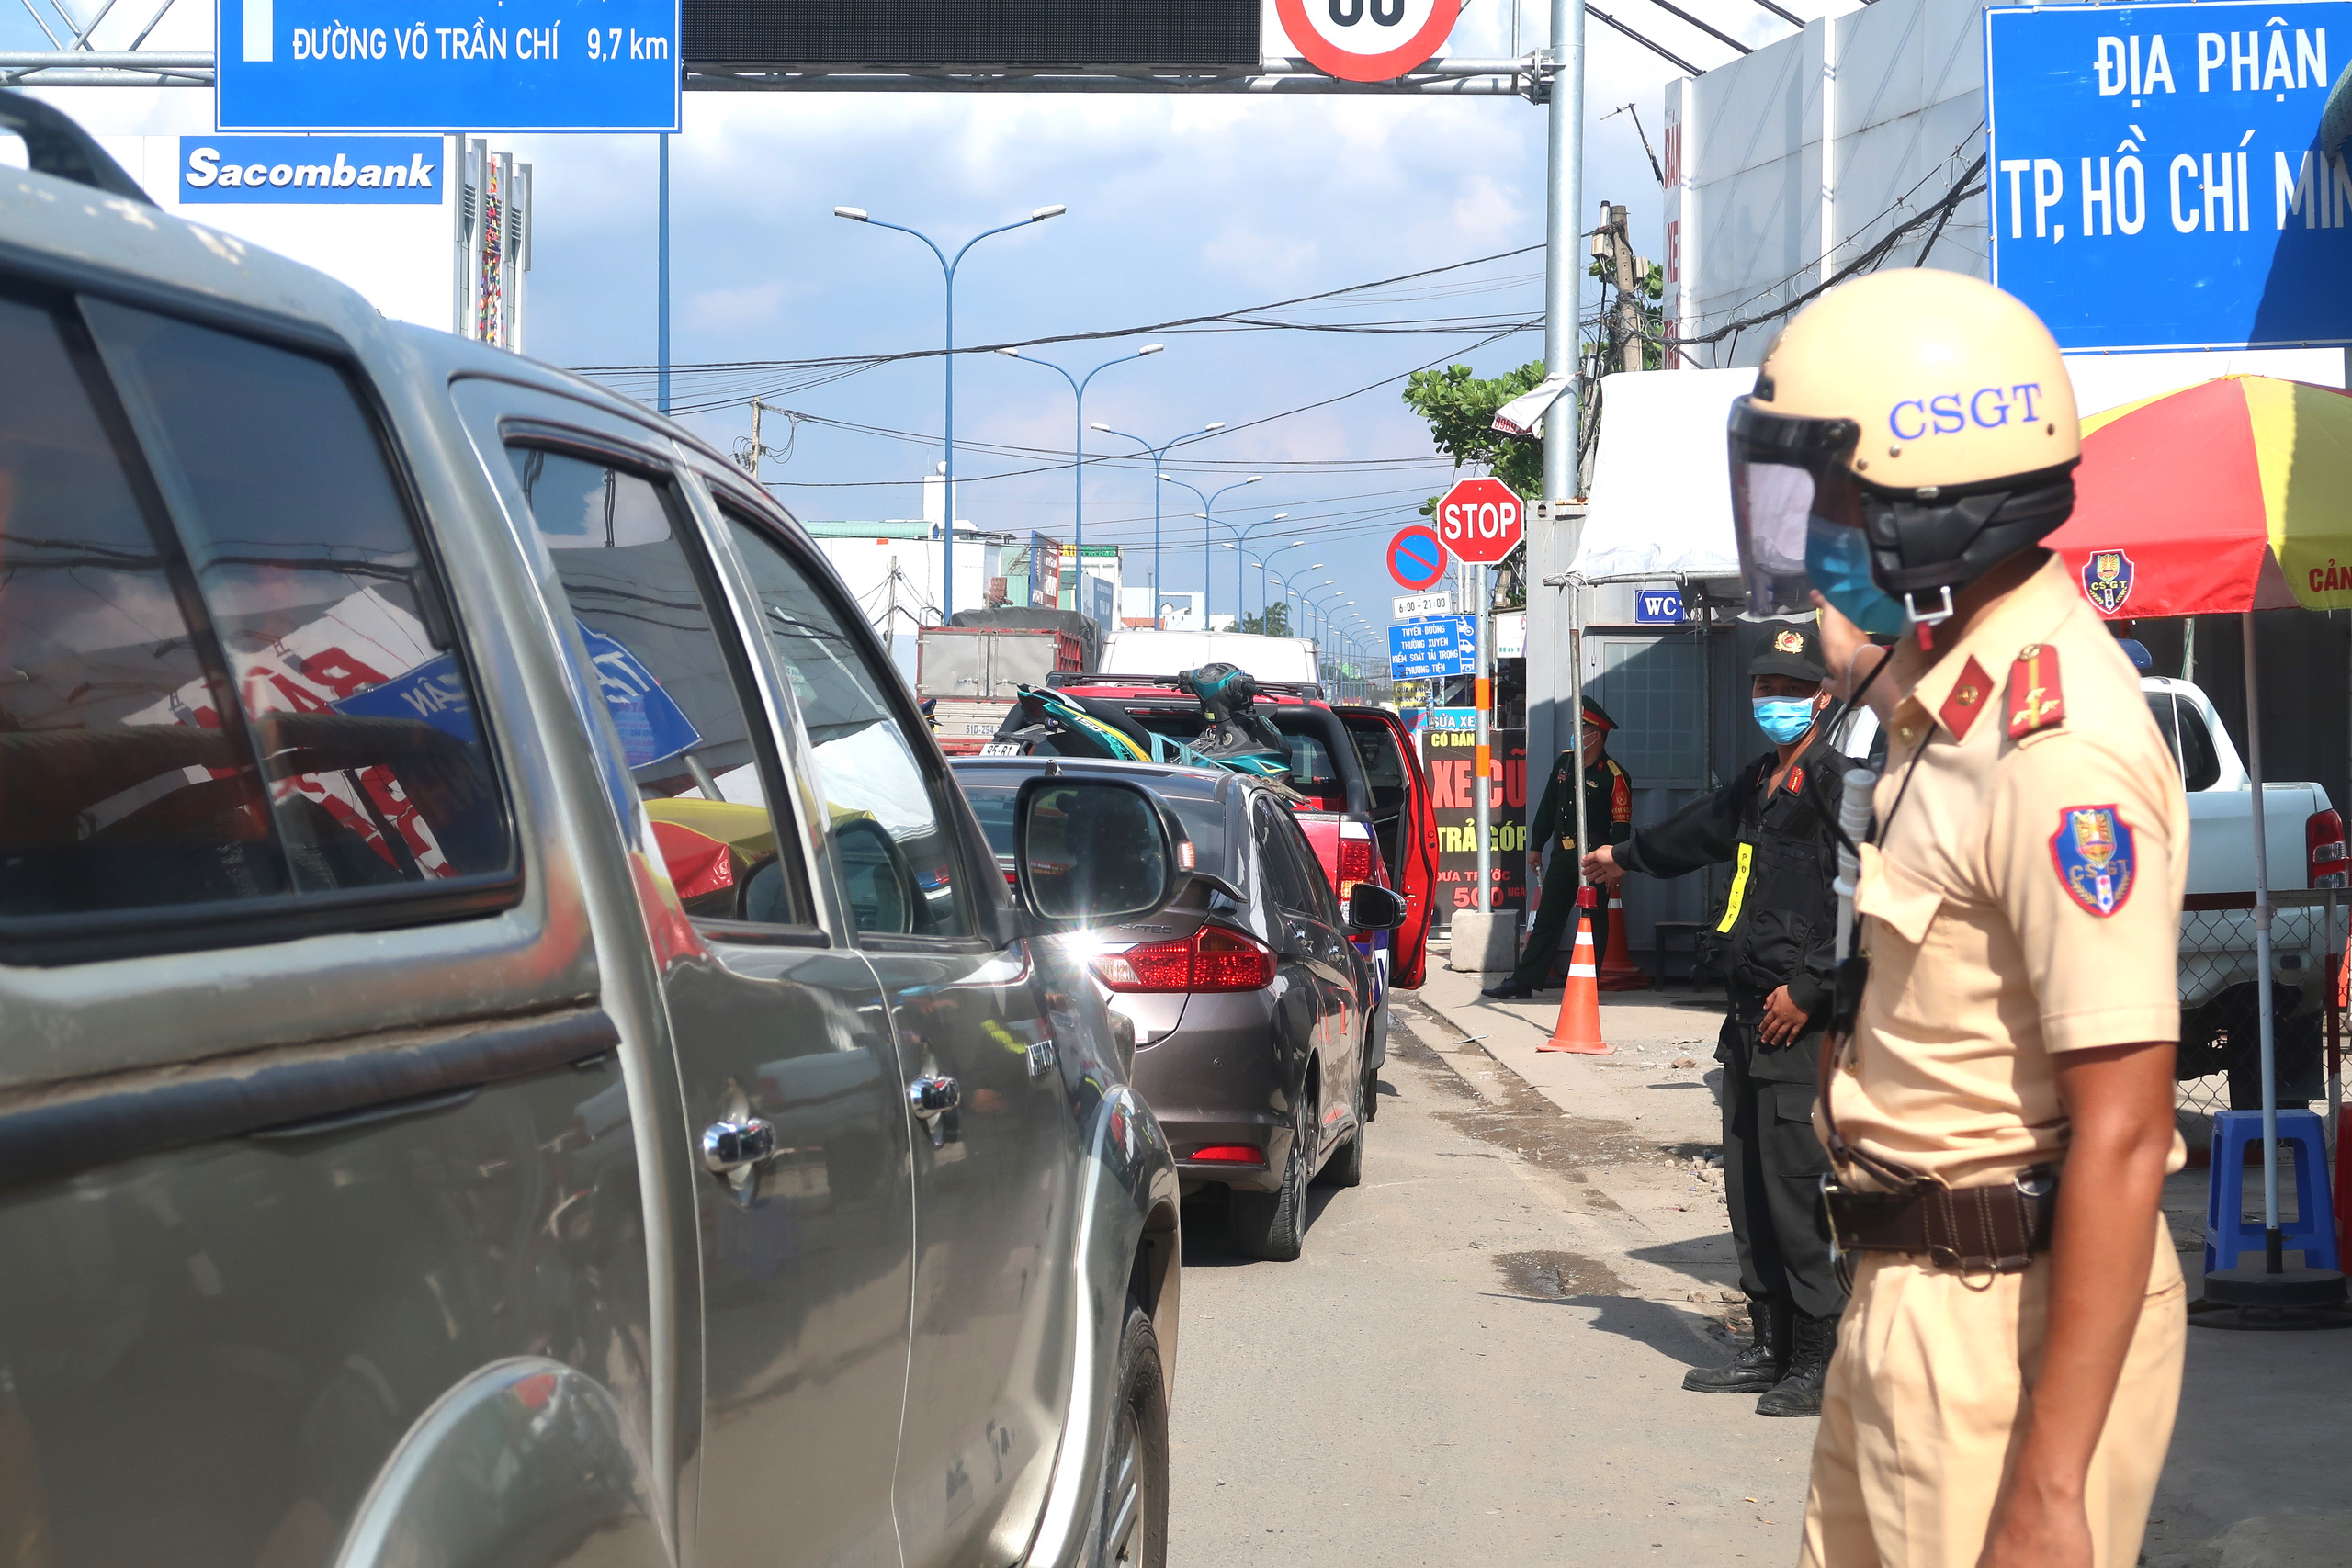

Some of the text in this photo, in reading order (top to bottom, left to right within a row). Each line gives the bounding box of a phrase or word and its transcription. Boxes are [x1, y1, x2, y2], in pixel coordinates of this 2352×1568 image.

[293, 17, 669, 63] ĐƯỜNG VÕ TRẦN CHÍ 9,7 km
[2093, 16, 2328, 108] ĐỊA PHẬN
[185, 146, 435, 189] Sacombank
[2081, 124, 2147, 236] HỒ
[2169, 129, 2256, 234] CHÍ
[1667, 220, 1679, 285] XE
[1889, 382, 2041, 441] CSGT
[1443, 502, 1517, 541] STOP
[1398, 602, 1415, 613] 6:00
[1423, 597, 1446, 610] 21:00
[1644, 596, 1677, 616] WC
[1401, 624, 1422, 637] TUYẾN
[1428, 636, 1449, 648] XUYÊN
[1409, 651, 1425, 662] SOÁT
[1439, 649, 1459, 660] TRỌNG
[1431, 662, 1446, 673] TIỆN
[1430, 731, 1476, 747] CÓ BÁN
[1459, 716, 1476, 728] XE
[1430, 760, 1473, 808] XE
[1437, 818, 1478, 852] TRẢ
